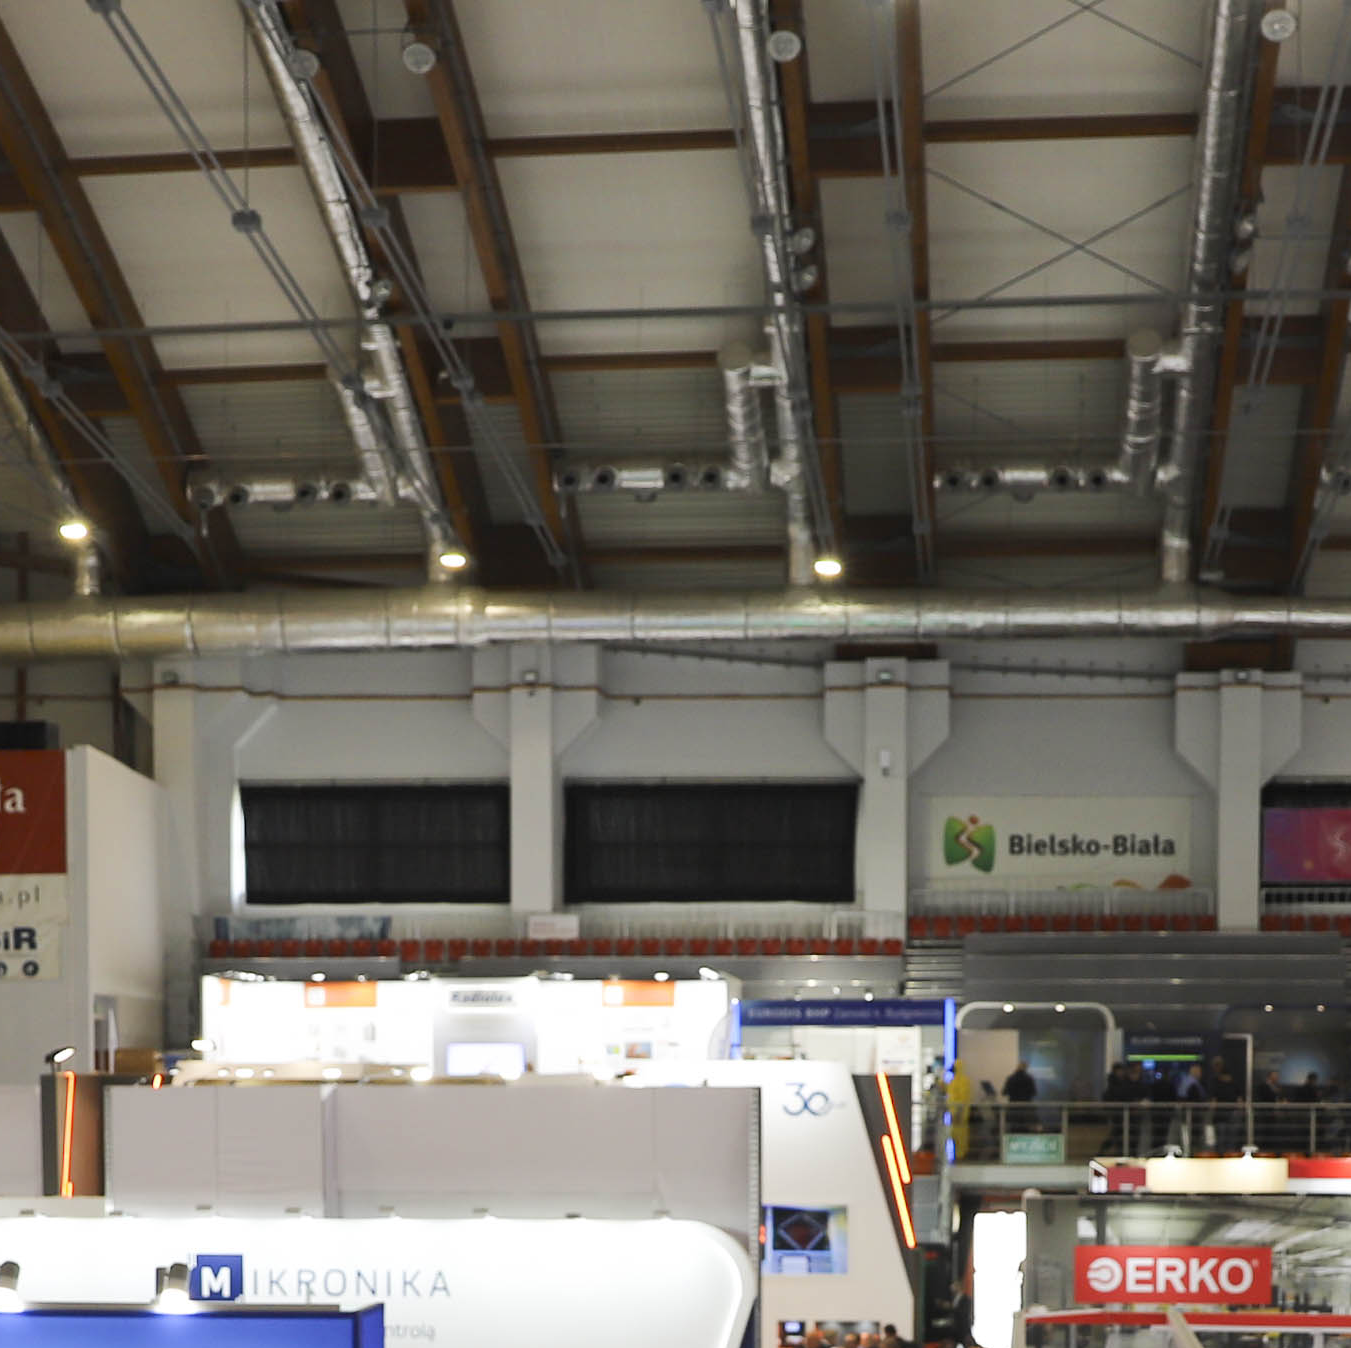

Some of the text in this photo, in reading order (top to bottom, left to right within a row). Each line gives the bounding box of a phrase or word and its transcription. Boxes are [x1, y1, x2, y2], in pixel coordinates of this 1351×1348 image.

[1007, 831, 1177, 858] Bielsko-Biała
[200, 1264, 452, 1299] MIKRONIKA
[1124, 1256, 1254, 1294] ERKO
[385, 1322, 436, 1341] ntrolą
